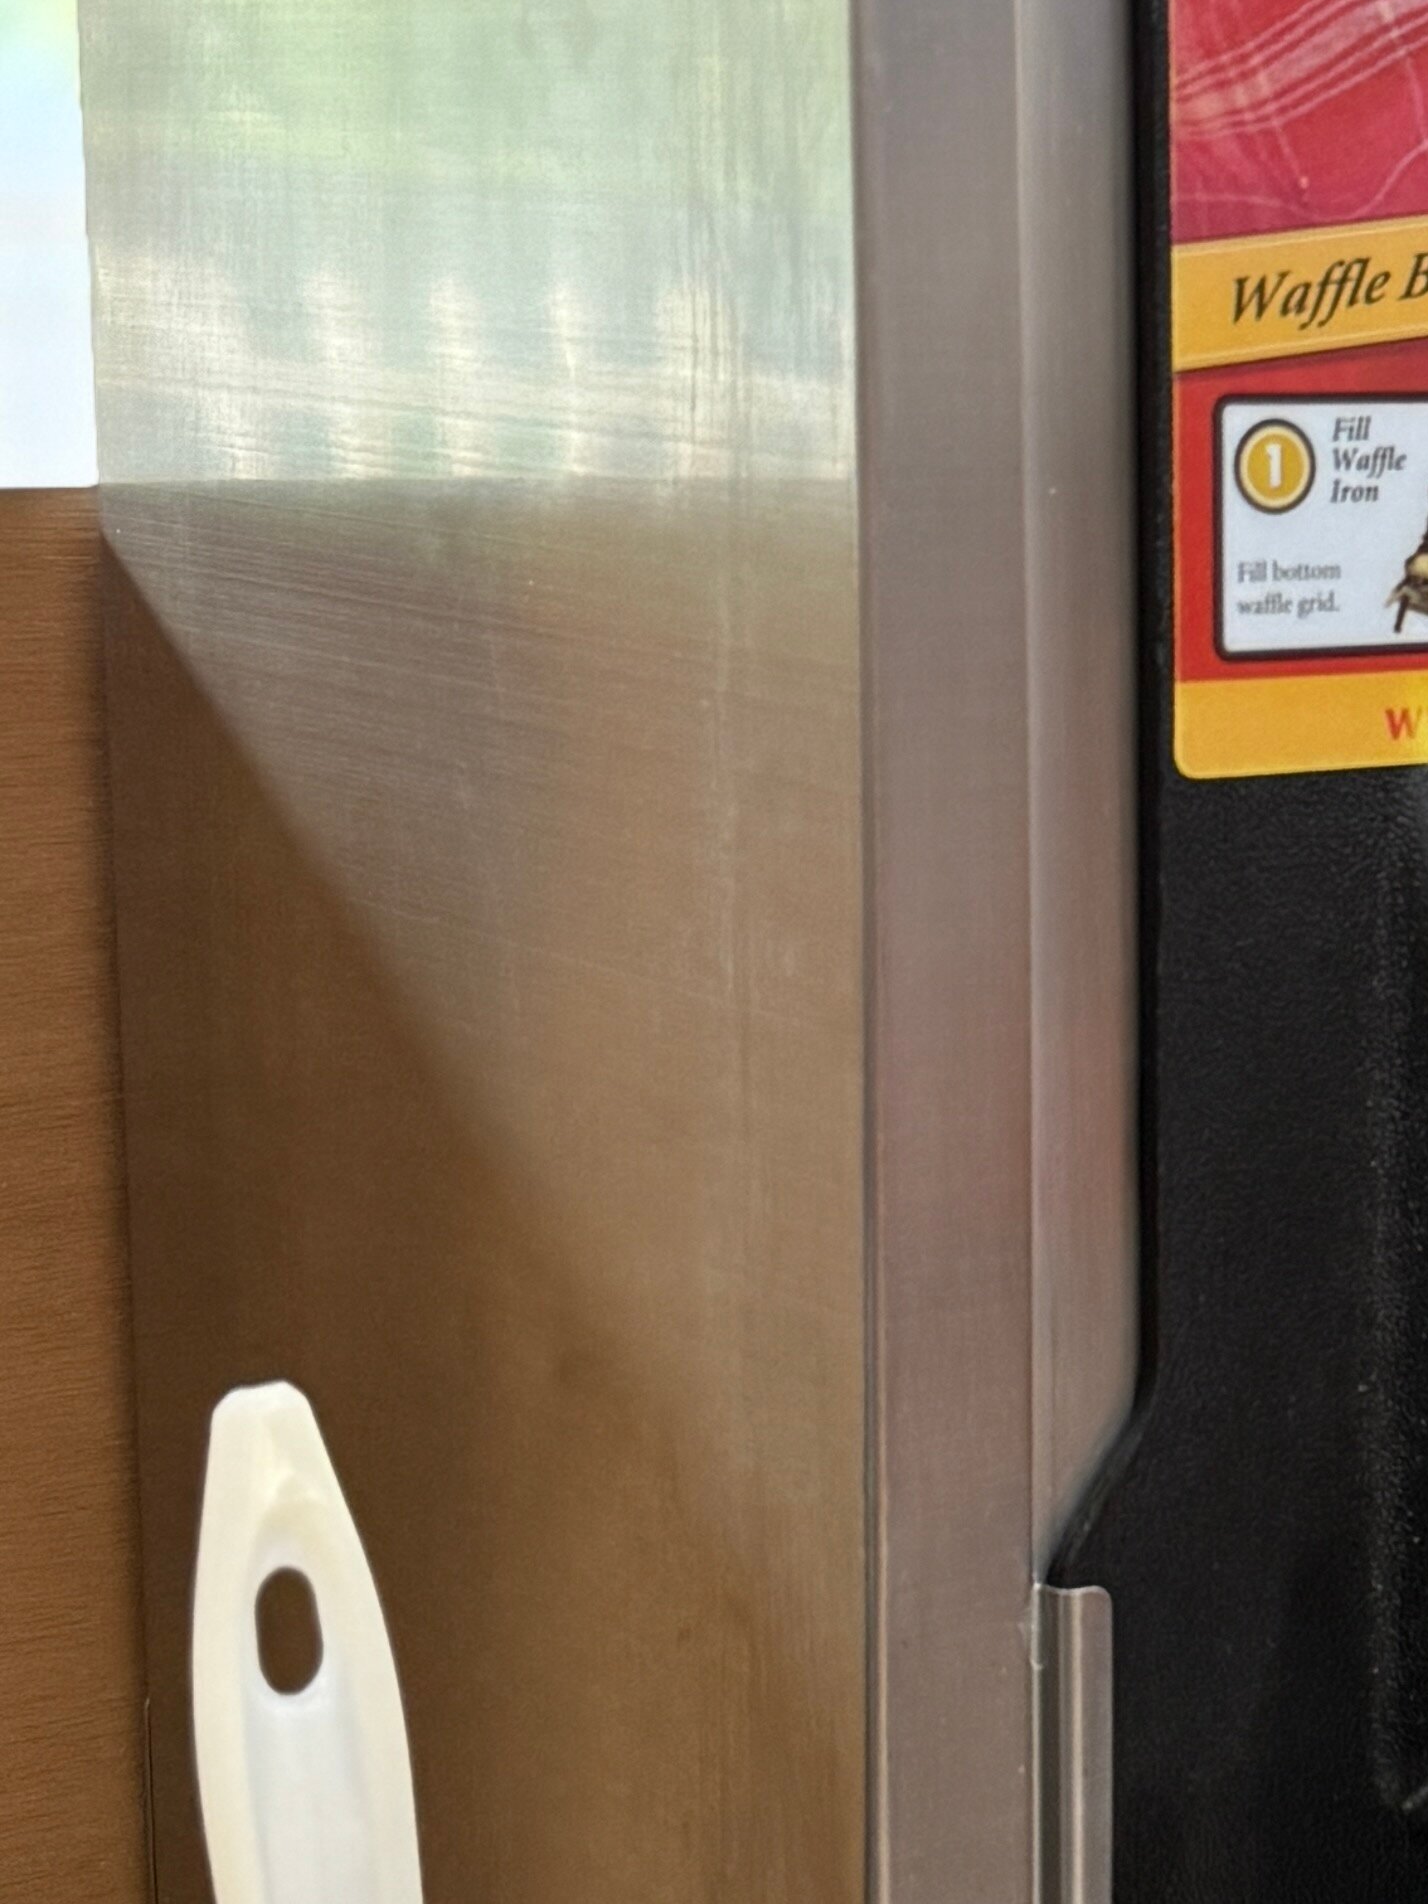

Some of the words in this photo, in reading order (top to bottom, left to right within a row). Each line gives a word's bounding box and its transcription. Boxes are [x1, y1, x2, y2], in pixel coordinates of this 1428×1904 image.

[1231, 257, 1393, 332] Waffle
[1331, 416, 1372, 442] Fill
[1265, 443, 1283, 489] 1
[1332, 446, 1407, 480] Waffle
[1329, 480, 1380, 504] Iron
[1238, 561, 1267, 584] Fill
[1272, 559, 1342, 582] bottom
[1238, 593, 1294, 617] waffle
[1297, 591, 1341, 619] grid.
